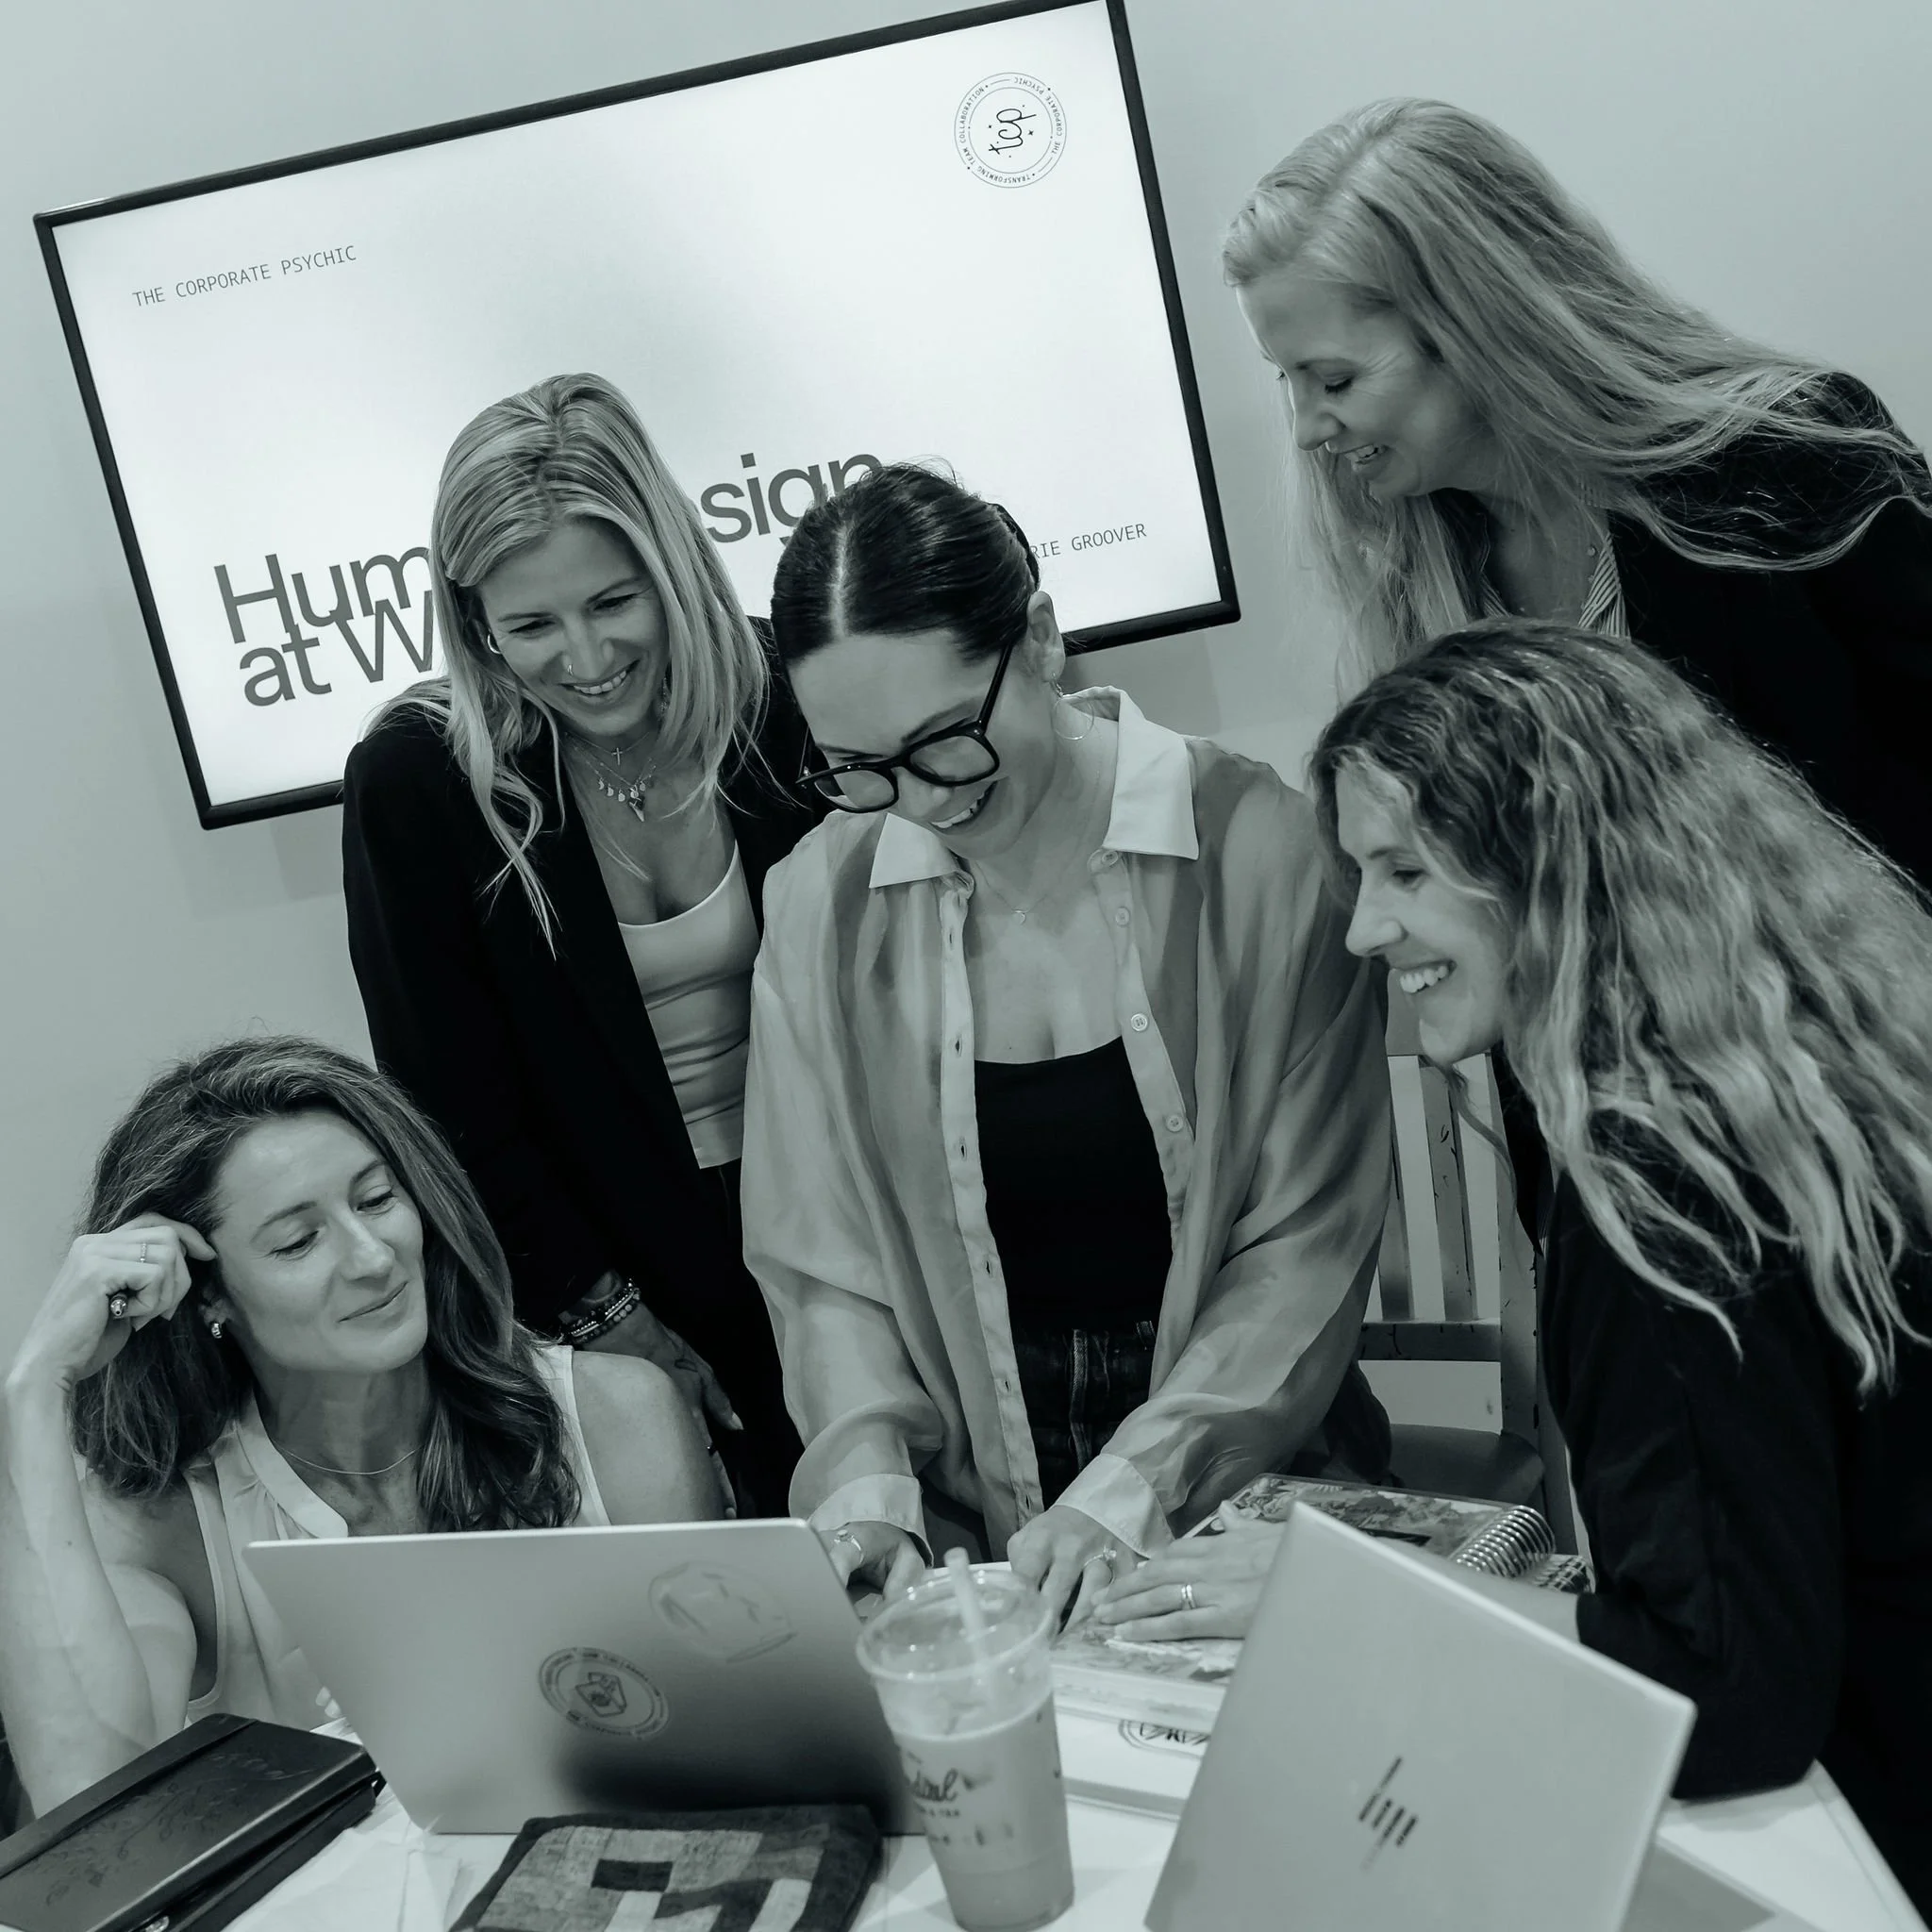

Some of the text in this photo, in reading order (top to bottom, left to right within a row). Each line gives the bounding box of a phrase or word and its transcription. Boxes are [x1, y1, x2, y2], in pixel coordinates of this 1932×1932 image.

[1013, 76, 1044, 95] PSYCHIC
[1045, 95, 1063, 137] CORPORATE
[958, 87, 1030, 184] TRANSFORMING TEAM COLLABORATION
[132, 245, 357, 307] THE CORPORATE PSYCHIC
[214, 452, 883, 644] Hum sign
[1029, 523, 1147, 558] RIE GROOVER
[240, 590, 435, 707] at W
